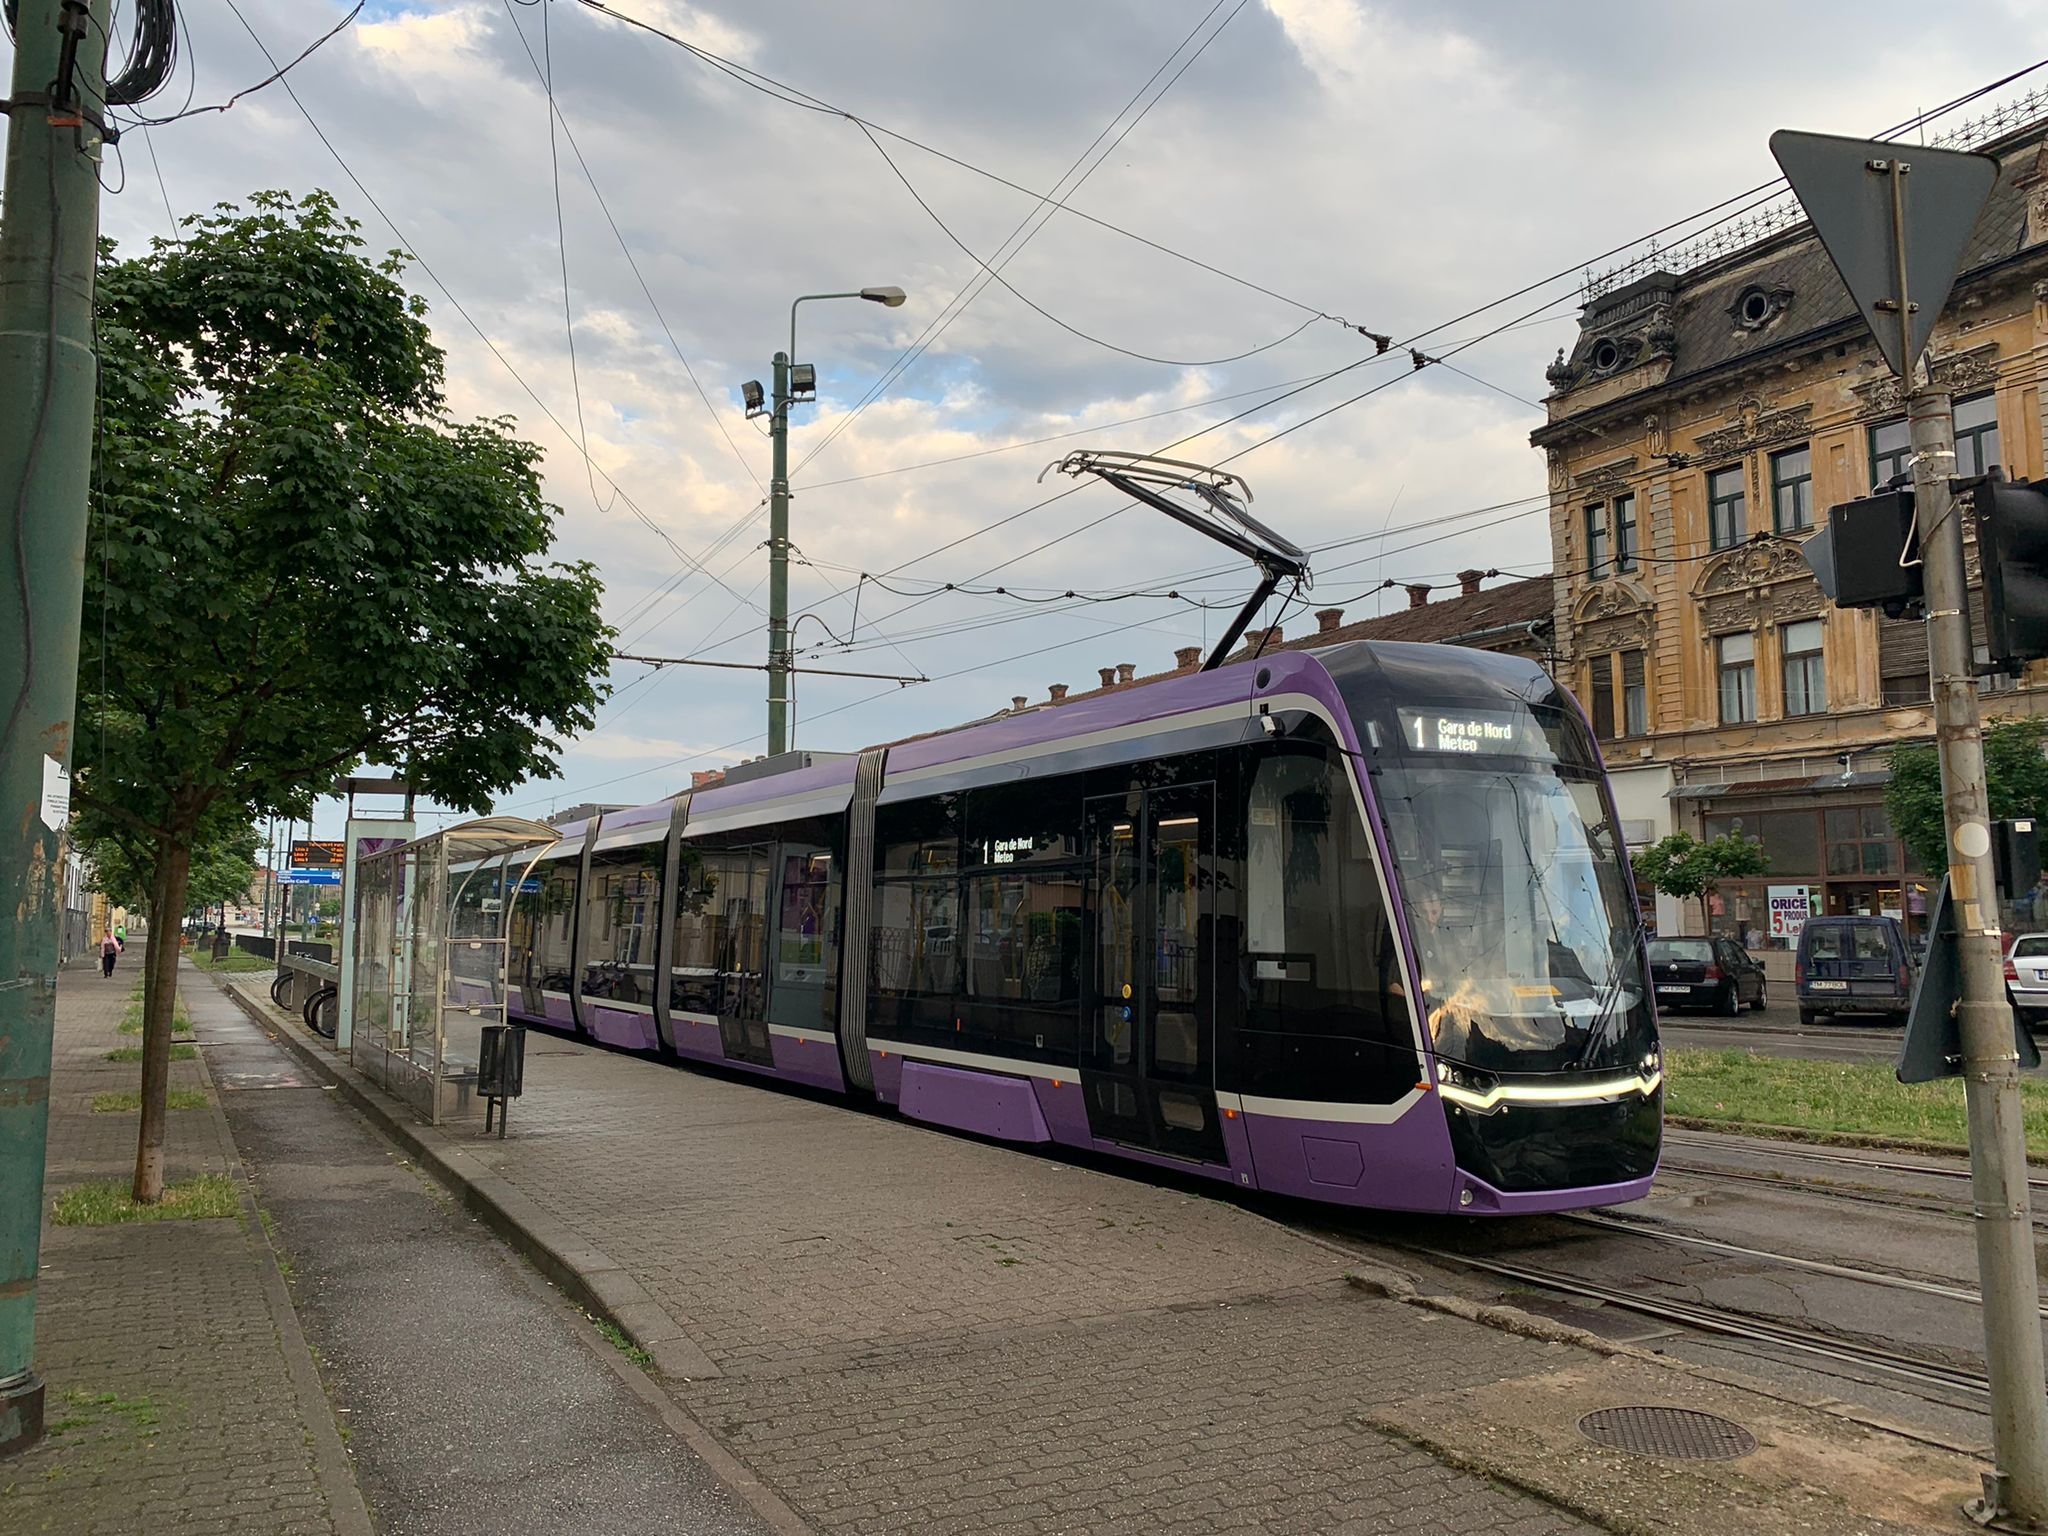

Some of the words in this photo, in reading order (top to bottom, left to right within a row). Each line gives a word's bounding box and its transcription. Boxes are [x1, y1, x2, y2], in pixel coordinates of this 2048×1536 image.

[1414, 717, 1424, 748] 1
[1438, 719, 1466, 736] Gara
[1468, 721, 1482, 737] de
[1484, 721, 1512, 740] Nord
[1438, 735, 1477, 752] Meteo
[983, 840, 988, 865] 1
[994, 840, 1008, 852] Gara
[1009, 838, 1017, 851] de
[1017, 836, 1033, 850] Nord
[994, 851, 1014, 864] Meteo
[1771, 899, 1808, 910] ORICE
[1773, 911, 1783, 934] 5
[1784, 911, 1808, 920] PRODUS
